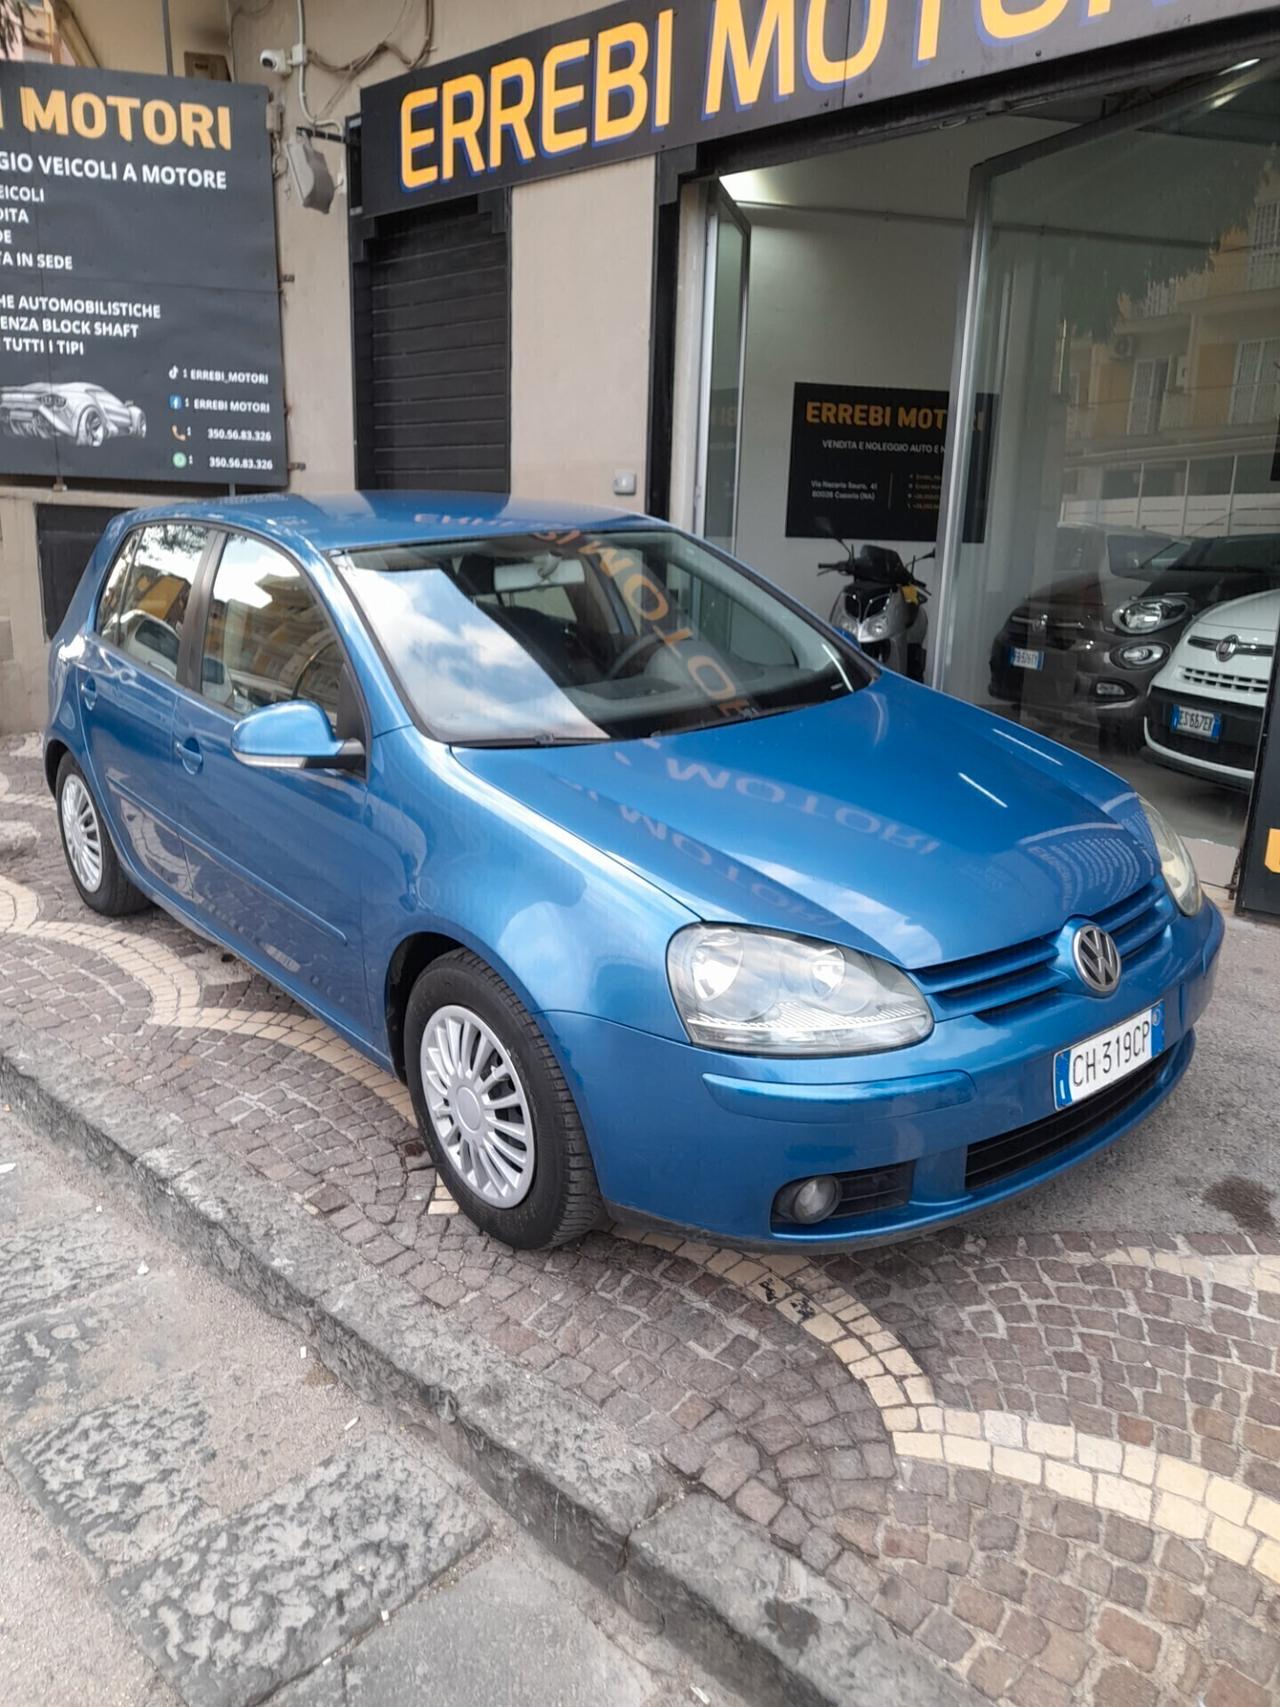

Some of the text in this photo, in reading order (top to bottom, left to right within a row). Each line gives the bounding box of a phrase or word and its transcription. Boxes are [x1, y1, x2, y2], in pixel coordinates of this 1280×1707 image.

[400, 8, 674, 191] ERREBI
[20, 86, 232, 150] MOTORI
[38, 155, 117, 180] VEICOLI
[123, 162, 137, 182] A
[142, 165, 227, 190] MOTORE
[16, 252, 33, 267] IN
[37, 253, 73, 270] SEDE
[18, 295, 161, 319] AUTOMOBILISTICHE
[42, 318, 91, 335] BLOCK
[94, 321, 139, 338] SHAFT
[3, 337, 84, 355] TUTTI I TIPI
[193, 398, 228, 411] ERREBI
[230, 400, 270, 413] MOTORI
[806, 401, 891, 427] ERREBI
[822, 439, 857, 449] VENDITA
[1072, 1047, 1097, 1087] CH
[1102, 1020, 1150, 1074] 319CP
